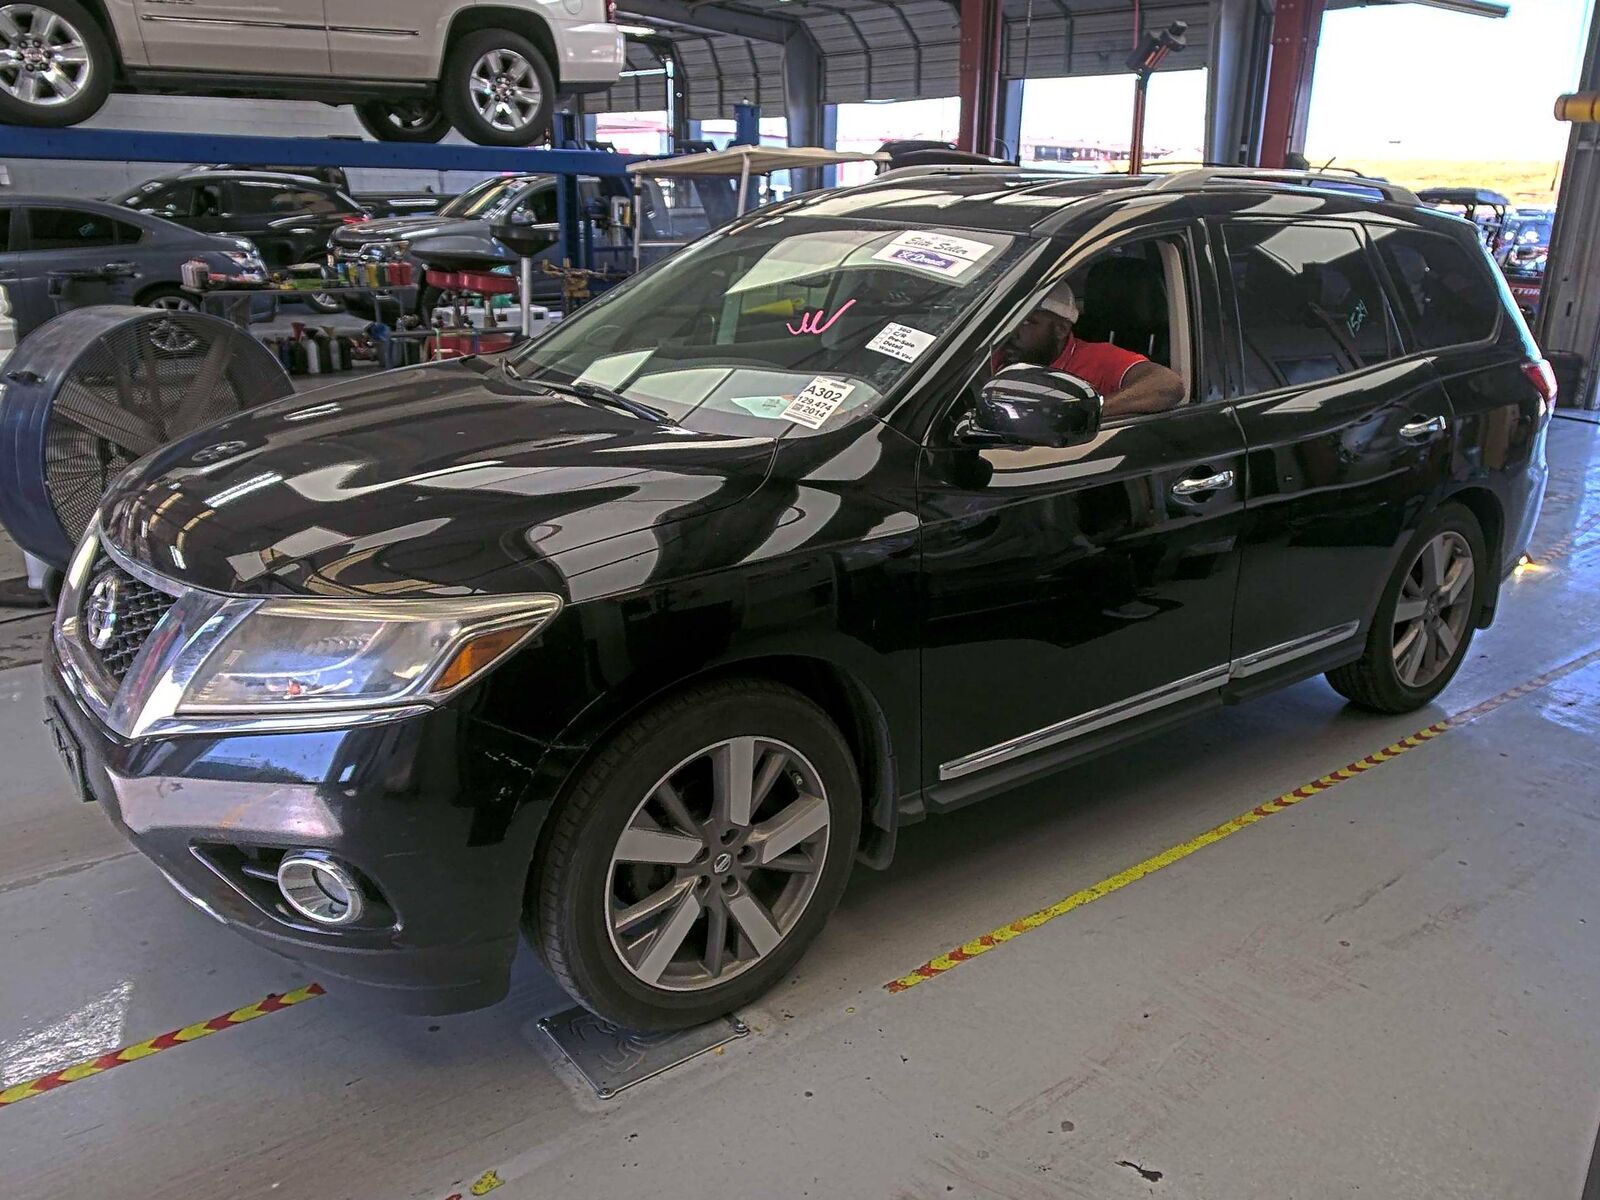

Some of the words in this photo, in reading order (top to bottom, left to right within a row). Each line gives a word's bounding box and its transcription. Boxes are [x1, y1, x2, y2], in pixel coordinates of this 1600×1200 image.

[883, 340, 904, 350] Detail
[888, 335, 915, 348] Pre-Sale
[879, 345, 895, 353] Wash
[804, 385, 842, 403] A302
[802, 406, 826, 418] 2014
